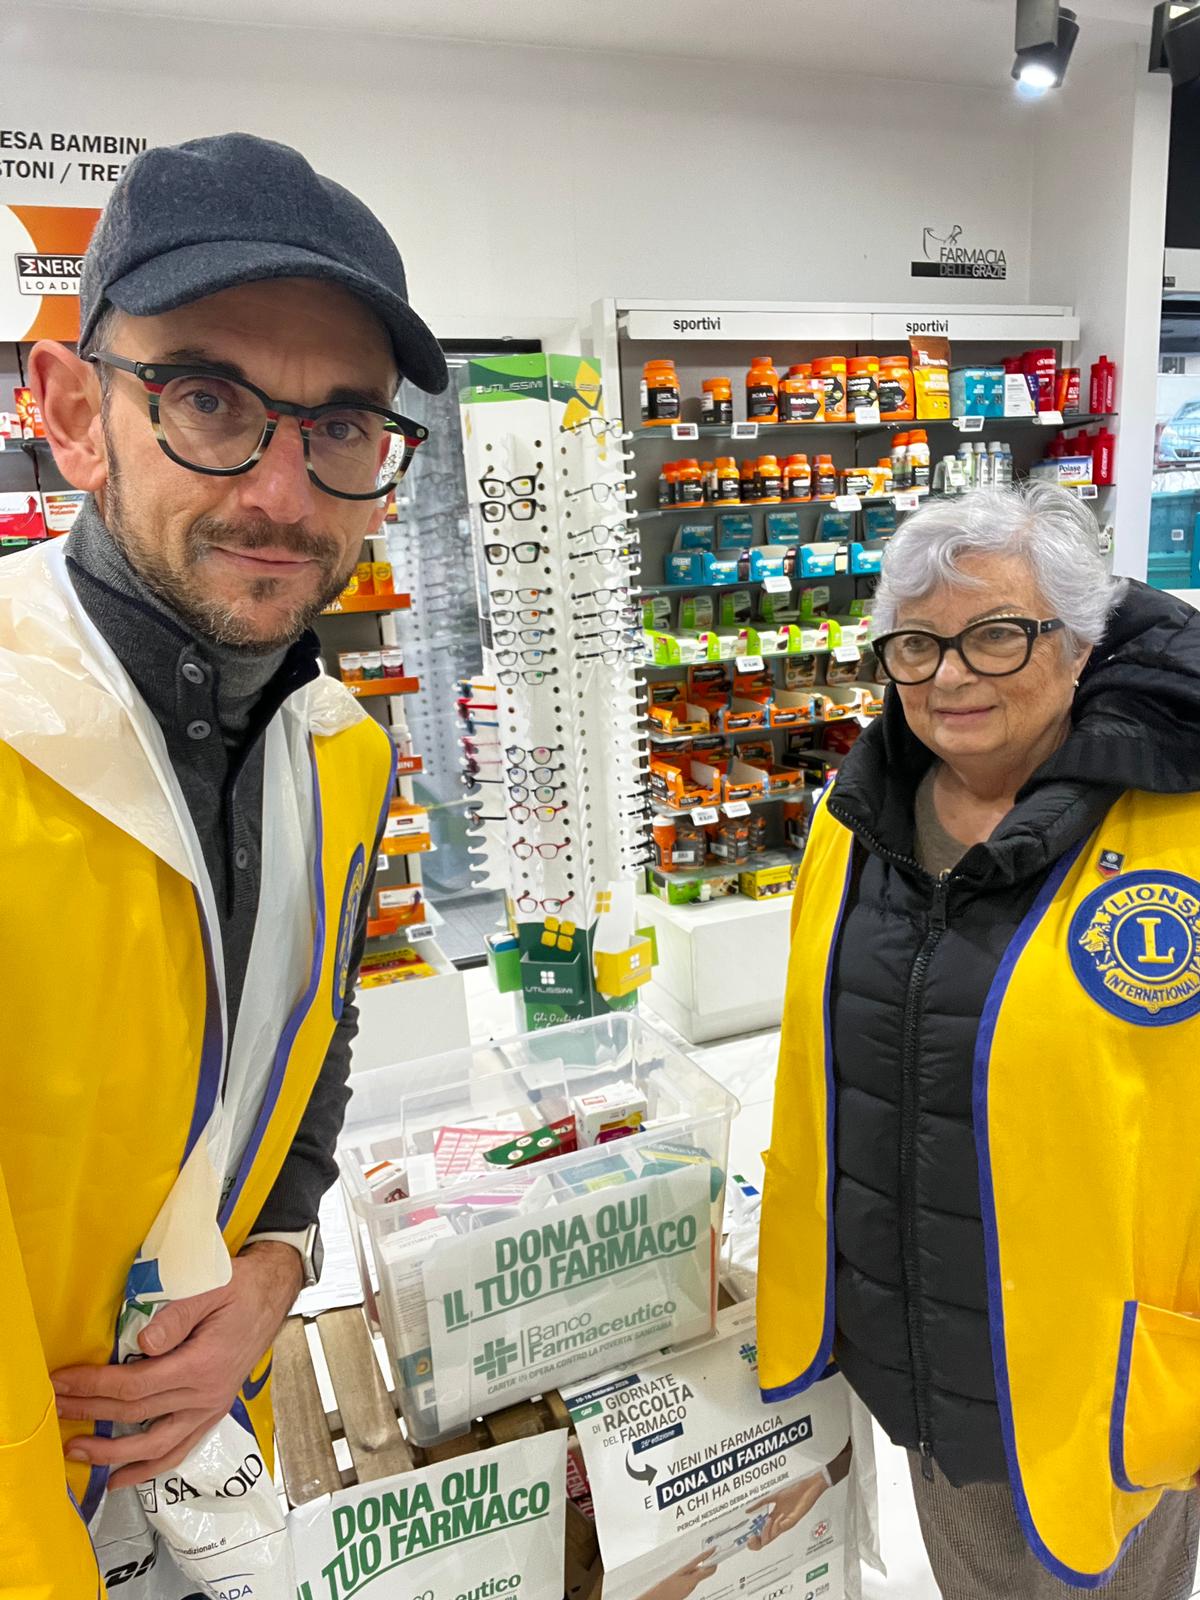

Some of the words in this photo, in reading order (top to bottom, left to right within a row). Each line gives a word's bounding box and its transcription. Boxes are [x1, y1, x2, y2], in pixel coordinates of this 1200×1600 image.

[51, 133, 147, 155] BAMBINI
[78, 163, 127, 181] TRE
[939, 247, 1007, 264] FARMACIA
[971, 264, 1007, 279] GRAZIE
[672, 315, 722, 333] sportivi
[905, 319, 949, 336] sportivi
[1109, 886, 1197, 914] LIONS
[1135, 917, 1175, 964] L
[1106, 974, 1200, 1003] INTERNATIONAL
[495, 1218, 591, 1273] DONA
[597, 1194, 648, 1238] QUI
[443, 1291, 472, 1327] IL
[475, 1263, 543, 1316] TUO
[549, 1215, 697, 1290] FARMACO
[529, 1311, 592, 1344] Banco
[529, 1298, 677, 1363] Farmaceutico
[592, 1424, 601, 1434] DI
[603, 1384, 694, 1432] RACCOLTA
[605, 1373, 676, 1410] GIORNATE
[603, 1436, 619, 1448] DEL
[619, 1405, 688, 1443] FARMACO
[650, 1429, 676, 1446] edizione
[667, 1453, 703, 1476] VIENI
[704, 1446, 718, 1462] IN
[720, 1415, 784, 1456] FARMACIA
[644, 1495, 654, 1510] E
[661, 1473, 709, 1504] DONA
[709, 1459, 735, 1484] UN
[736, 1421, 810, 1469] FARMACO
[675, 1504, 686, 1520] A
[686, 1493, 711, 1514] CHI
[712, 1484, 731, 1504] HA
[733, 1454, 788, 1493] BISOGNO
[333, 1485, 436, 1551] DONA
[441, 1462, 499, 1507] QUI
[321, 1533, 383, 1600] TUO
[389, 1480, 551, 1561] FARMACO
[454, 1573, 522, 1600] eutico
